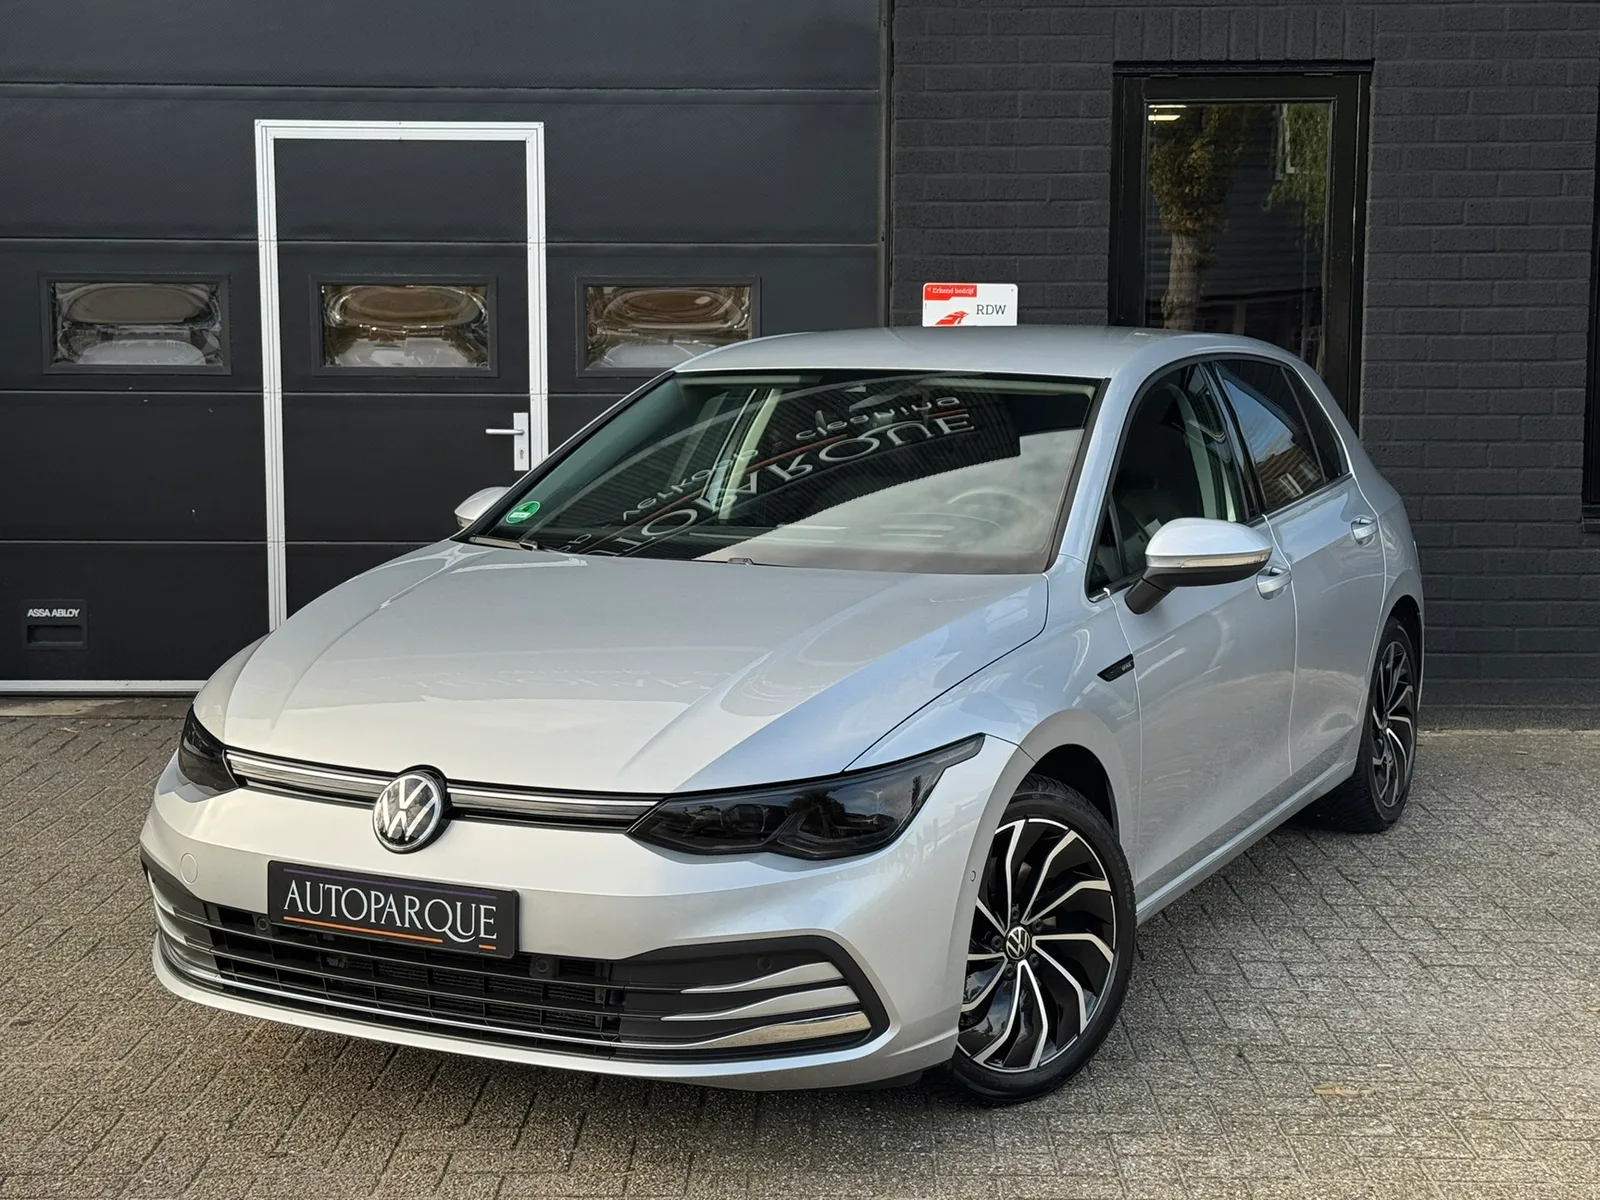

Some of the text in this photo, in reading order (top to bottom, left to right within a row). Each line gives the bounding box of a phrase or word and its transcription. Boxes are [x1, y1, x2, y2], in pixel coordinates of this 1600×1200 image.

[932, 287, 975, 296] Erkend bedrijf
[976, 304, 1007, 315] RDW
[27, 608, 80, 617] ASSA ABLOY
[283, 879, 498, 944] AUTOPARQUE
